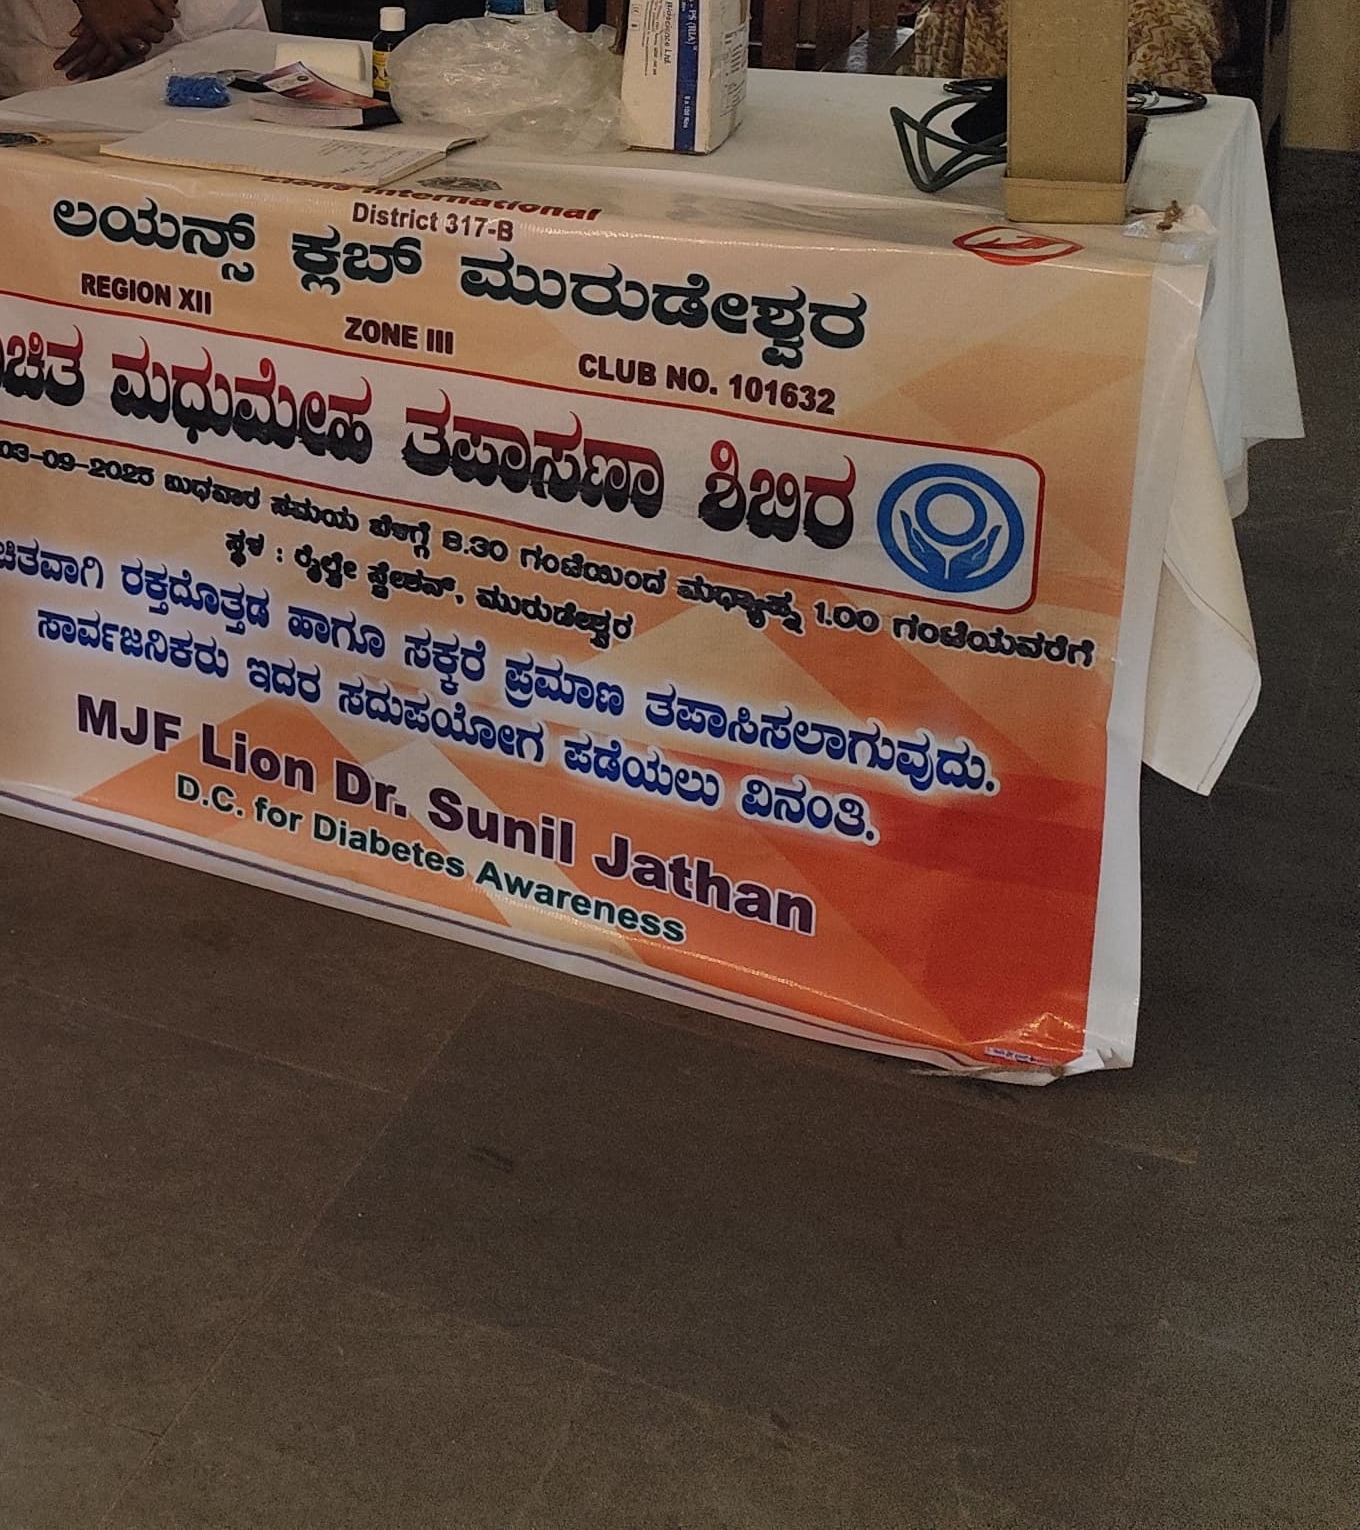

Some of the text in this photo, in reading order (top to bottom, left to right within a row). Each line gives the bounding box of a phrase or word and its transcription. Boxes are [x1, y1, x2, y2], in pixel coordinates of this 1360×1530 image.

[53, 196, 868, 370] ಲಯನ್ಸ್ ಕ್ಲಬ್ ಮುರುಡೇಶ್ವರ
[81, 273, 212, 315] REGION XII
[352, 202, 514, 242] District 317-B
[344, 316, 454, 354] ZONE III
[579, 353, 837, 416] CLUB NO. 101632
[111, 335, 373, 464] ಮಧುಮೇಹ
[402, 387, 666, 518] ತಪಾಸಣಾ
[697, 438, 857, 550] ಶಿಬಿರ
[164, 472, 261, 509] ಬುಧವಾರ
[271, 493, 359, 531] ಸಮಯ
[442, 529, 508, 562] 8.30
[814, 600, 880, 633] 1.00
[892, 613, 1095, 668] ಗಂಟೆಯವರೆಗೆ
[476, 585, 633, 650] ಮುರುಡೇಶ್ವರ
[37, 608, 876, 842] ಸಾರ್ವಜನಿಕರು ಇದರ ಸದುಪಯೋಗ ಪಡೆಯಲು ವಿನಂತಿ.
[120, 557, 270, 635] ರಕ್ತದೊತ್ತಡ
[288, 604, 386, 658] ಹಾಗೂ
[404, 628, 487, 696] ಸಕ್ಕರೆ
[504, 651, 625, 717] ಪ್ರಮಾಣ
[645, 683, 997, 792] ತಪಾಸಿಸಲಾಗುವುದು.
[77, 693, 816, 935] MJF Lion Dr. Sunil Jathan
[176, 773, 686, 944] D.C. for Diabetes Awareness
